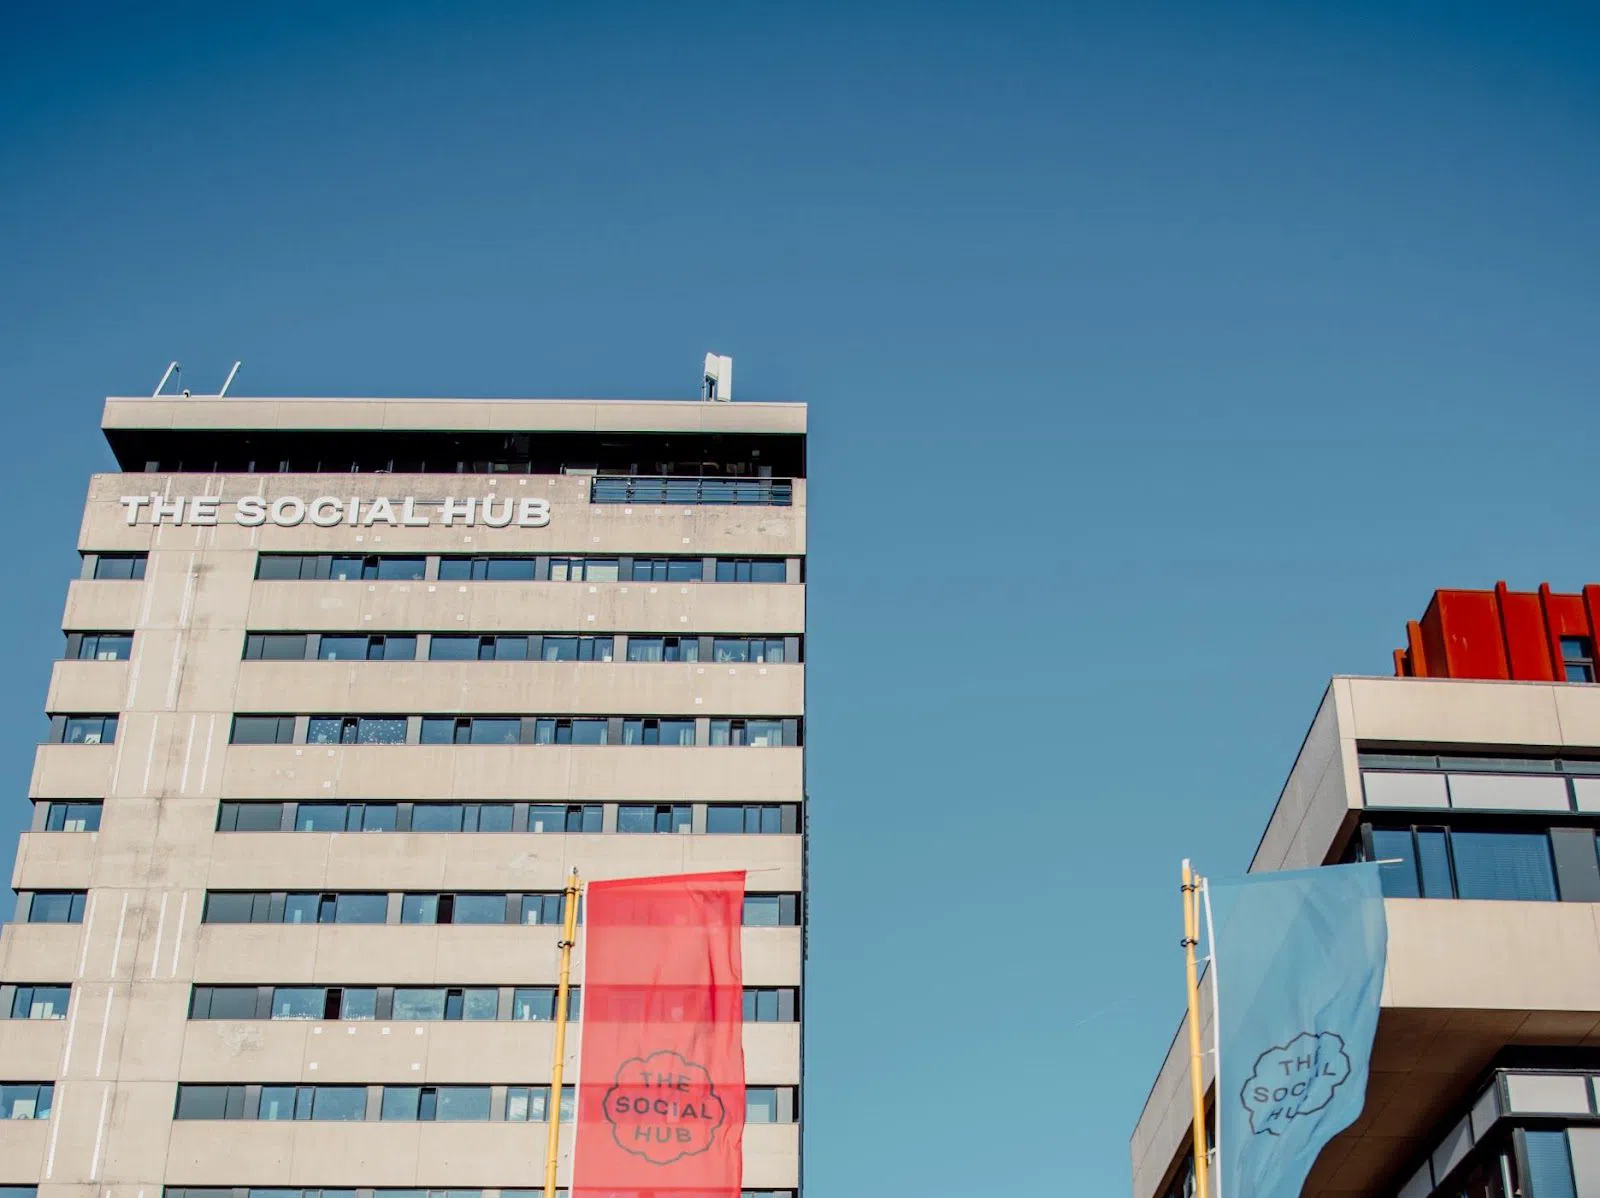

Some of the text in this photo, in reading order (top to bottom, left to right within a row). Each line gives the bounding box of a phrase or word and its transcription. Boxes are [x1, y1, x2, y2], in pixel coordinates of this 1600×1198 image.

[120, 496, 551, 528] THE SOCIAL HUB
[1278, 1046, 1320, 1076] TH
[640, 1072, 692, 1093] THE
[615, 1096, 713, 1120] SOCIAL
[1266, 1106, 1297, 1122] HU
[634, 1125, 692, 1143] HUB
